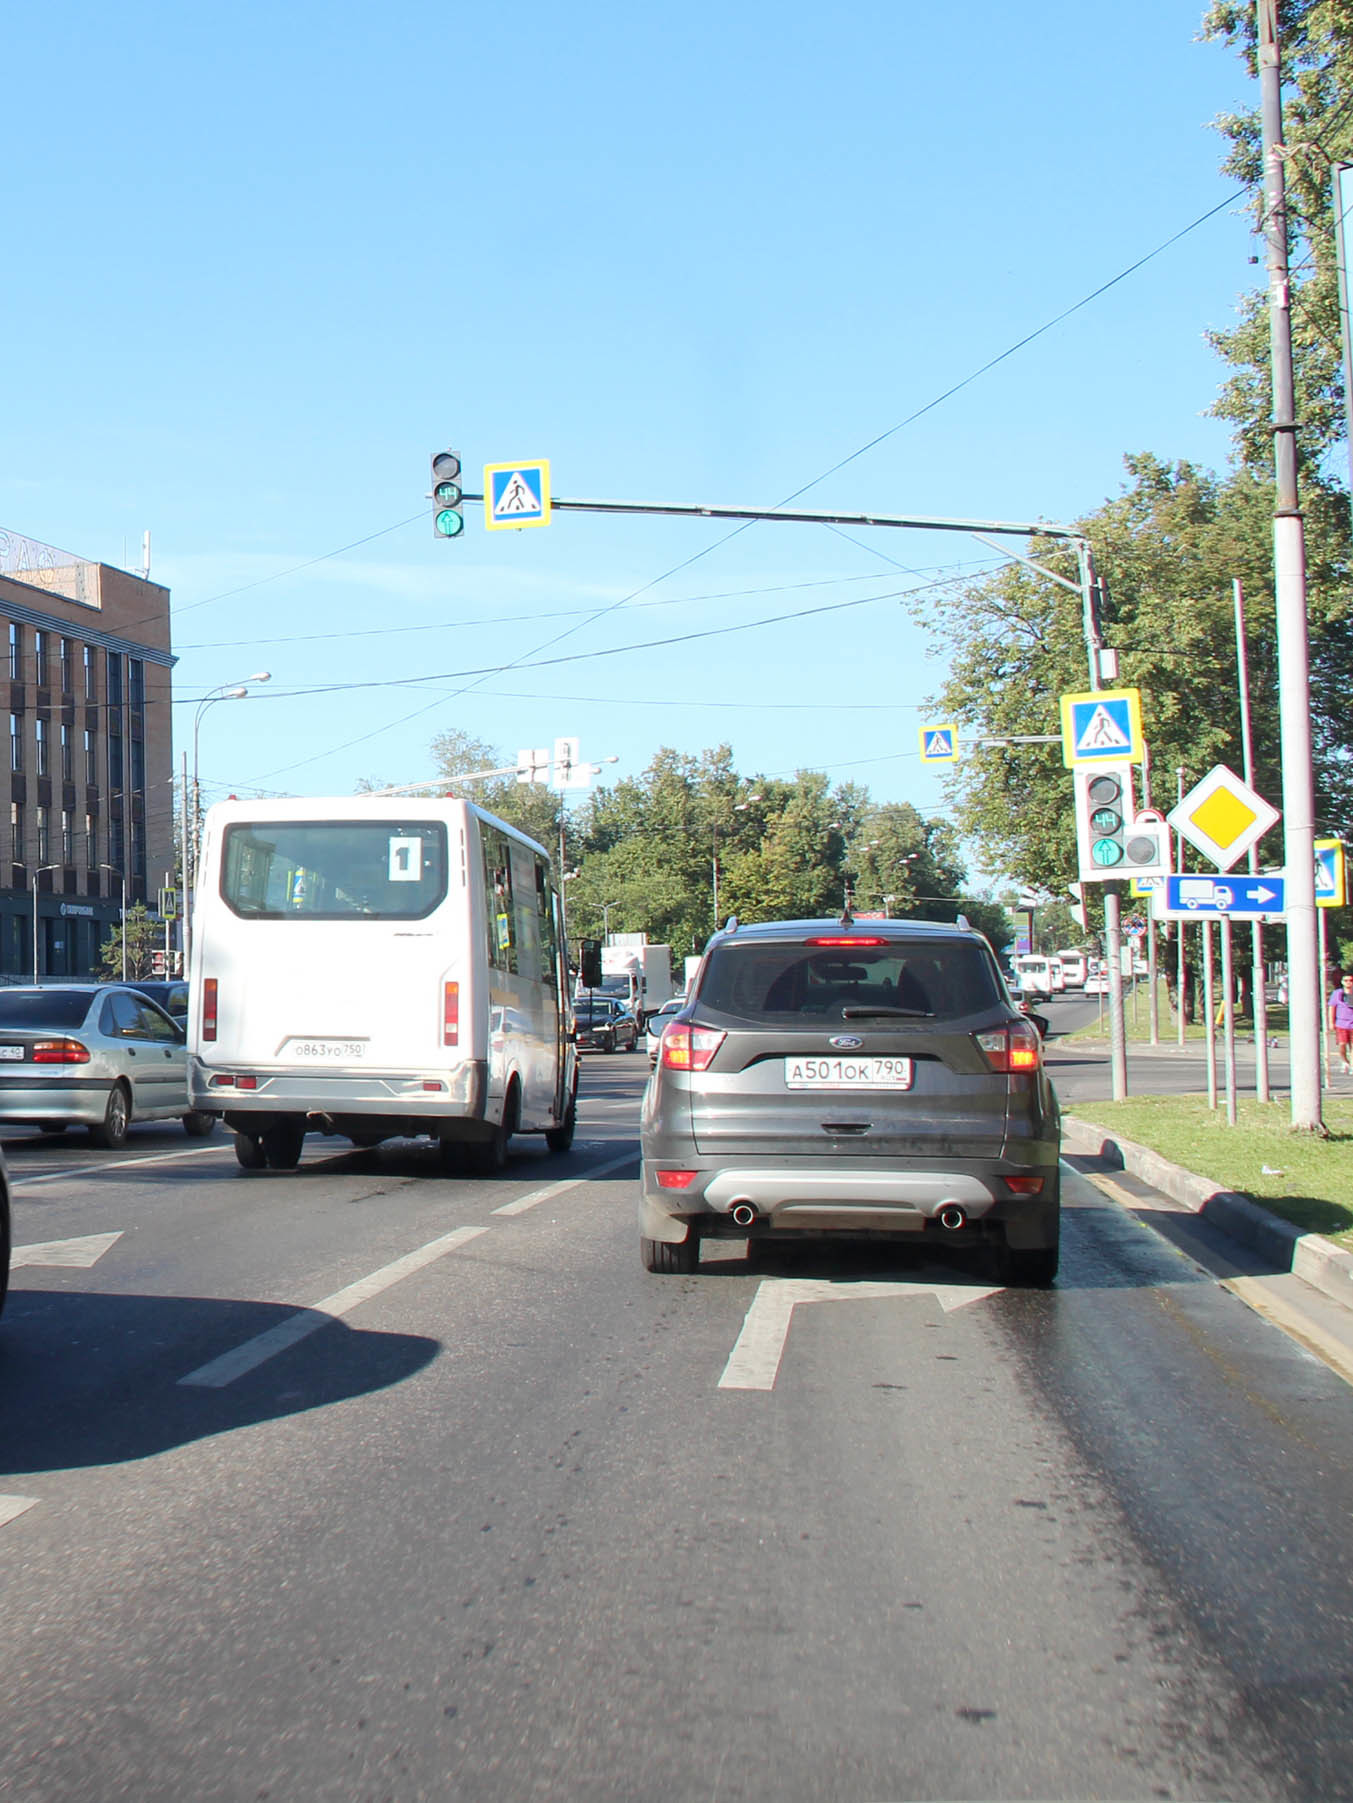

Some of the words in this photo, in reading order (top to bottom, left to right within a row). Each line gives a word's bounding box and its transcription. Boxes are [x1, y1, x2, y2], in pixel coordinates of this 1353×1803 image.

[439, 487, 457, 501] 44
[1095, 813, 1116, 828] 44
[395, 847, 408, 870] 1
[792, 1060, 869, 1079] А501ОК
[874, 1060, 904, 1075] 790
